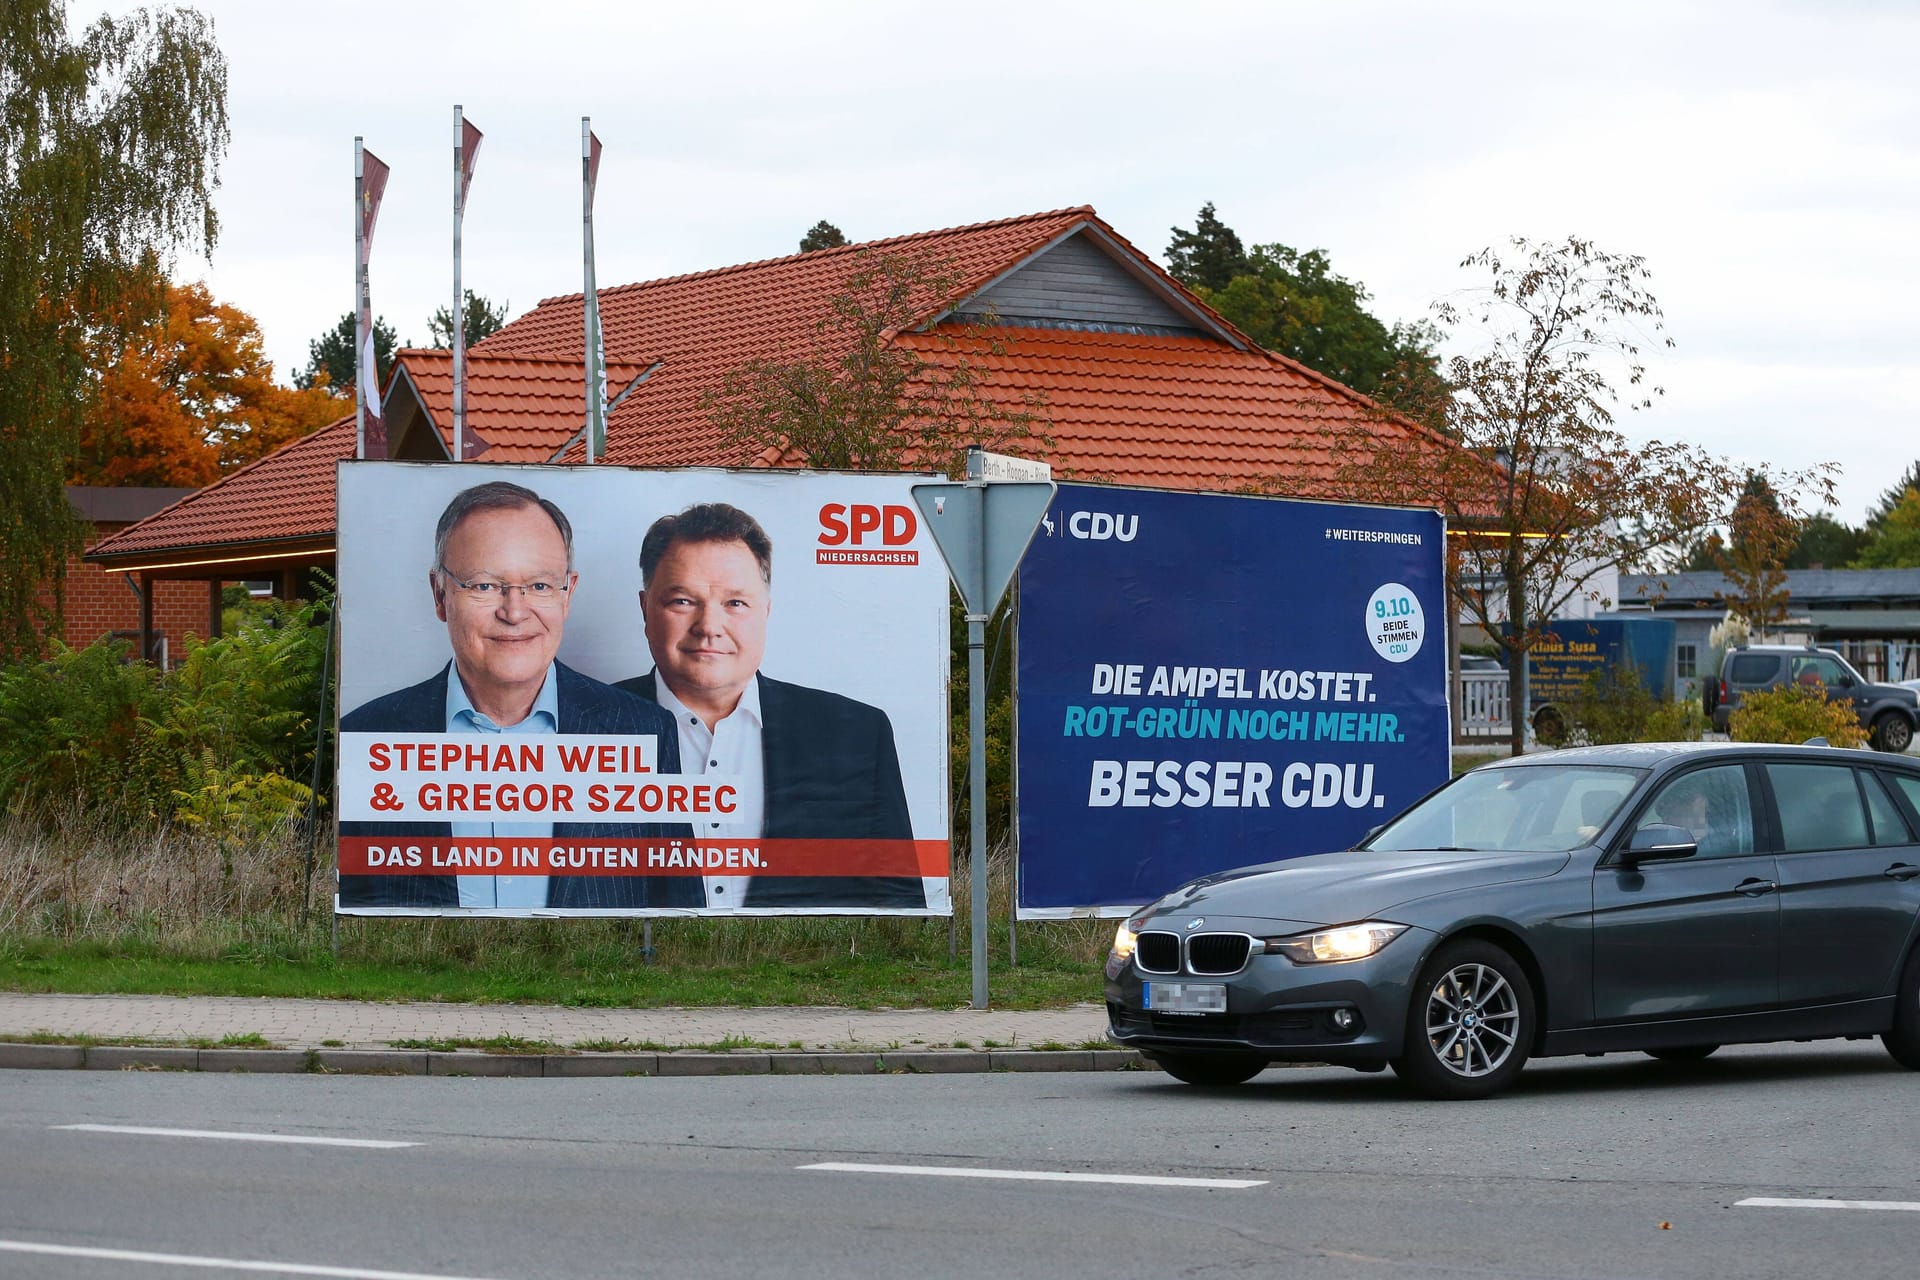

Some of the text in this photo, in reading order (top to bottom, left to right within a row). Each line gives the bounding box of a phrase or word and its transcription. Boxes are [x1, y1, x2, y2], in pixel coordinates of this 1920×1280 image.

[817, 503, 918, 546] SPD
[1069, 511, 1139, 542] CDU
[1325, 528, 1422, 545] #WEITERSPRINGEN
[819, 552, 915, 563] NIEDERSACHSEN
[1375, 597, 1415, 618] 9.10.
[1377, 631, 1418, 644] STIMMEN
[1383, 620, 1409, 632] BEIDE
[1389, 643, 1408, 654] CDU
[1092, 663, 1377, 702] DIE AMPEL KOSTET.
[1064, 699, 1405, 742] ROT-GRÜN NOCH MEHR.
[368, 742, 651, 773] STEPHAN WEIL
[369, 782, 738, 814] & GREGOR SZOREC
[1088, 760, 1385, 808] BESSER CDU.
[367, 840, 768, 868] DAS LAND IN GUTEN HÄNDEN.
